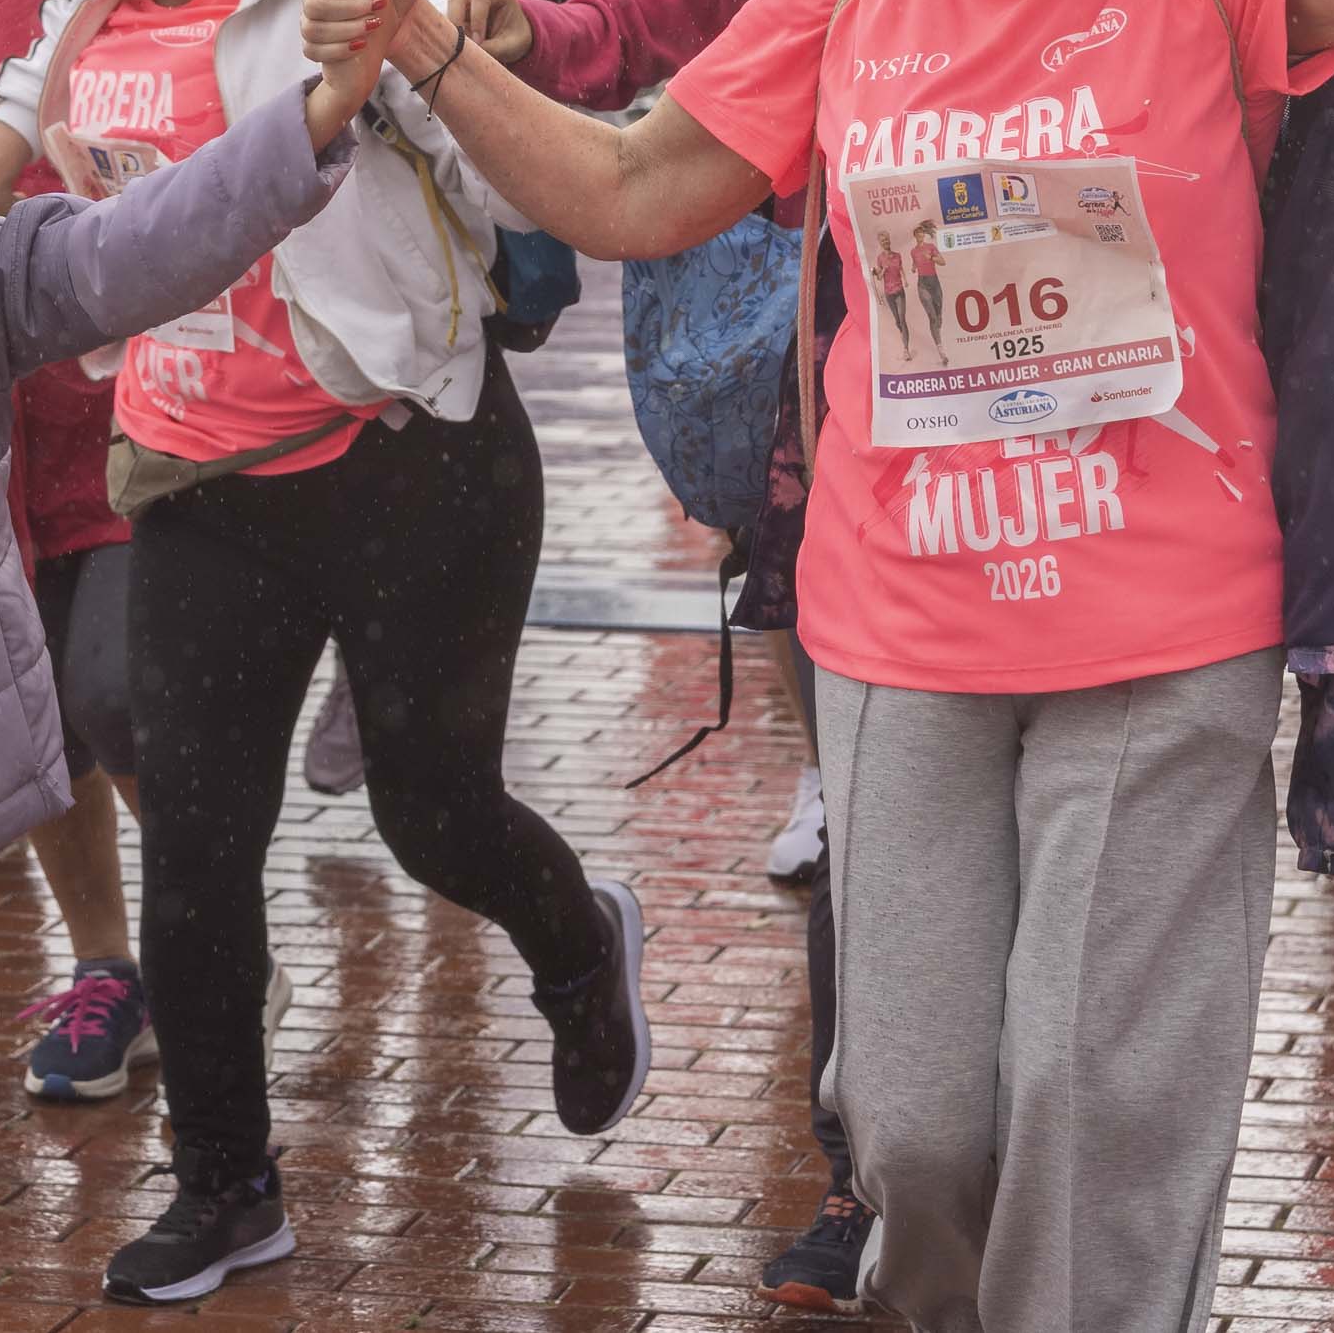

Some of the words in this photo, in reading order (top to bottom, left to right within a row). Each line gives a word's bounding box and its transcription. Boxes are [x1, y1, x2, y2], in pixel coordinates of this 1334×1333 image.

[867, 189, 879, 199] TU
[882, 184, 920, 198] DORSAL
[871, 195, 921, 216] SUMA
[955, 277, 1068, 333] 016
[990, 335, 1045, 360] 1925
[887, 372, 947, 395] CARRERA
[948, 370, 965, 390] DE
[967, 368, 986, 388] LA
[989, 364, 1040, 386] MUJER
[1052, 354, 1094, 376] GRAN
[1097, 344, 1163, 368] CANARIA
[1103, 385, 1153, 401] Santander
[994, 402, 1053, 419] ASTURIANA
[906, 415, 959, 430] OYSHO
[906, 451, 1125, 556] MUJER
[984, 555, 1061, 601] 2026
